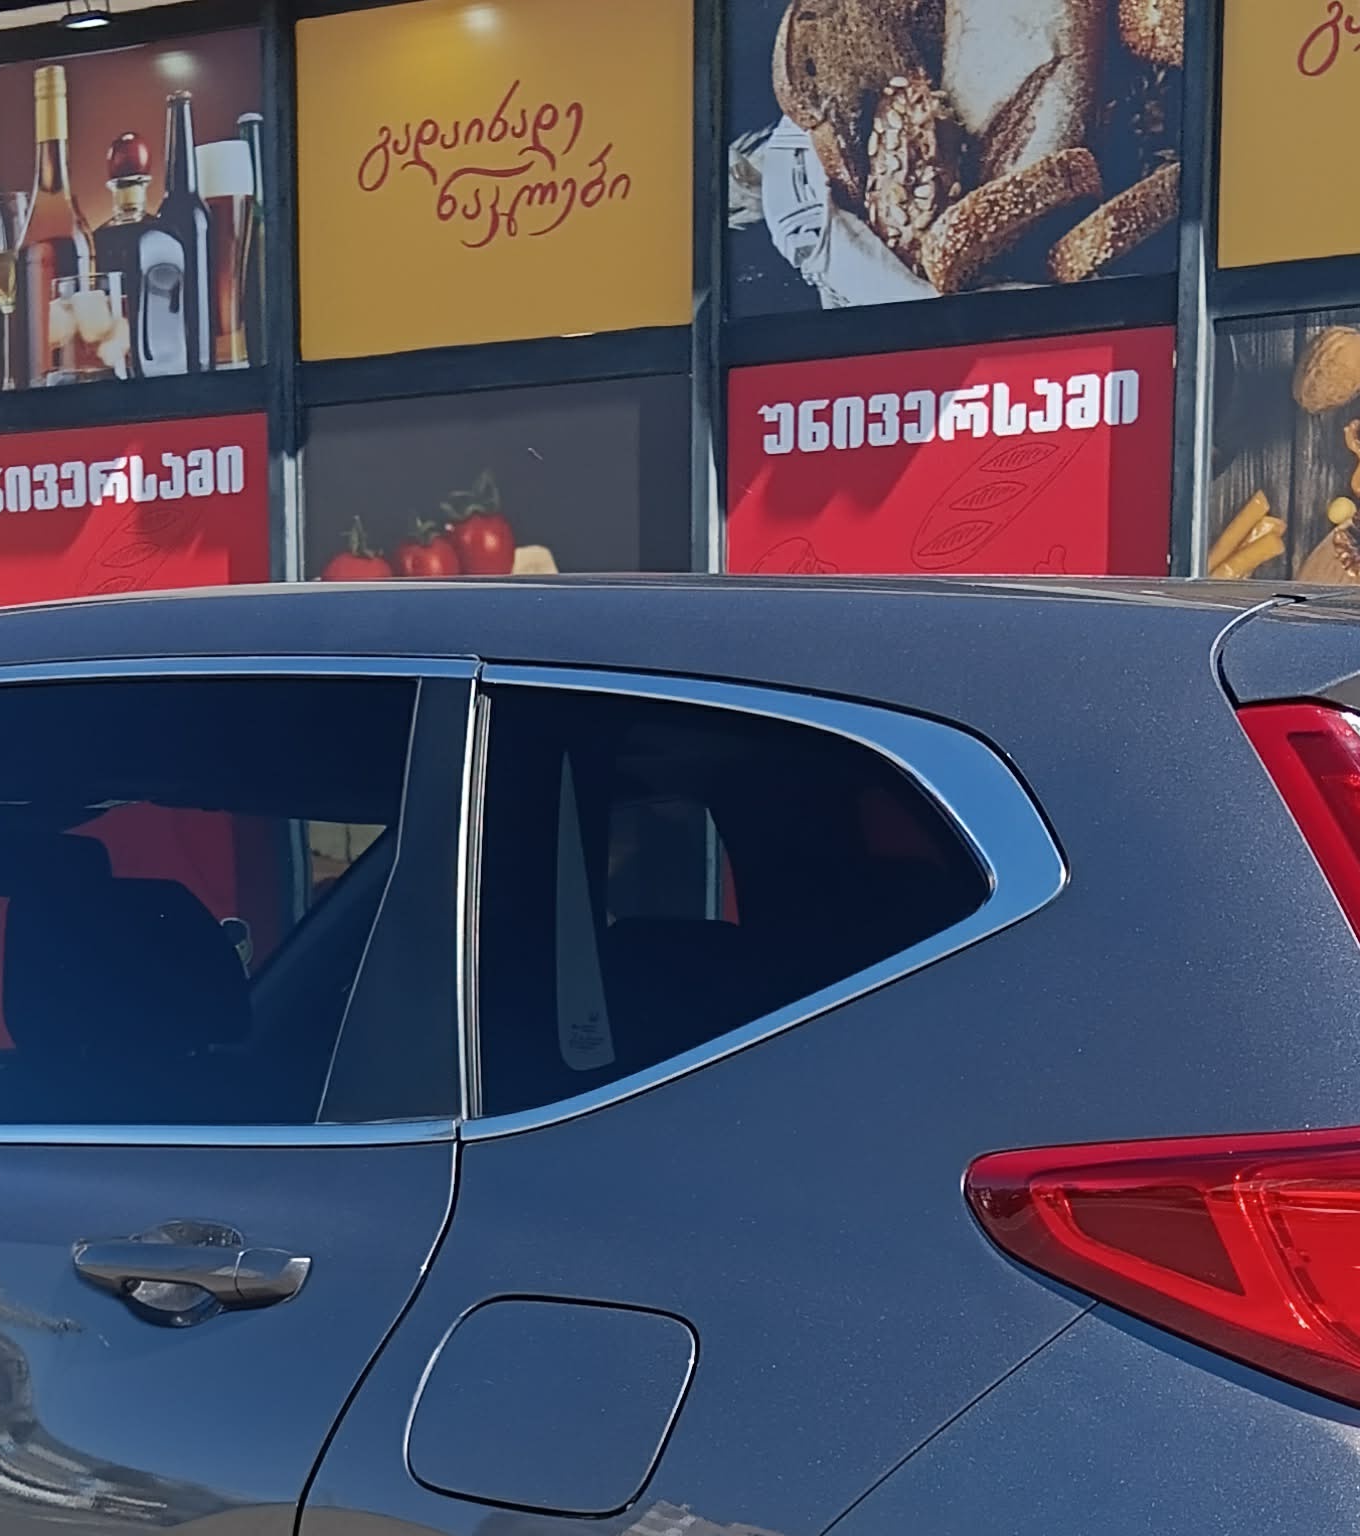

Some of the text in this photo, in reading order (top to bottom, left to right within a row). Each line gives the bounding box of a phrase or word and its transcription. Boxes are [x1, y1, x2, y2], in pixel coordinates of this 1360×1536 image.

[358, 79, 584, 192] გადაიხადე
[437, 142, 631, 248] ნაკლები
[757, 369, 1140, 455] უნივერსამი
